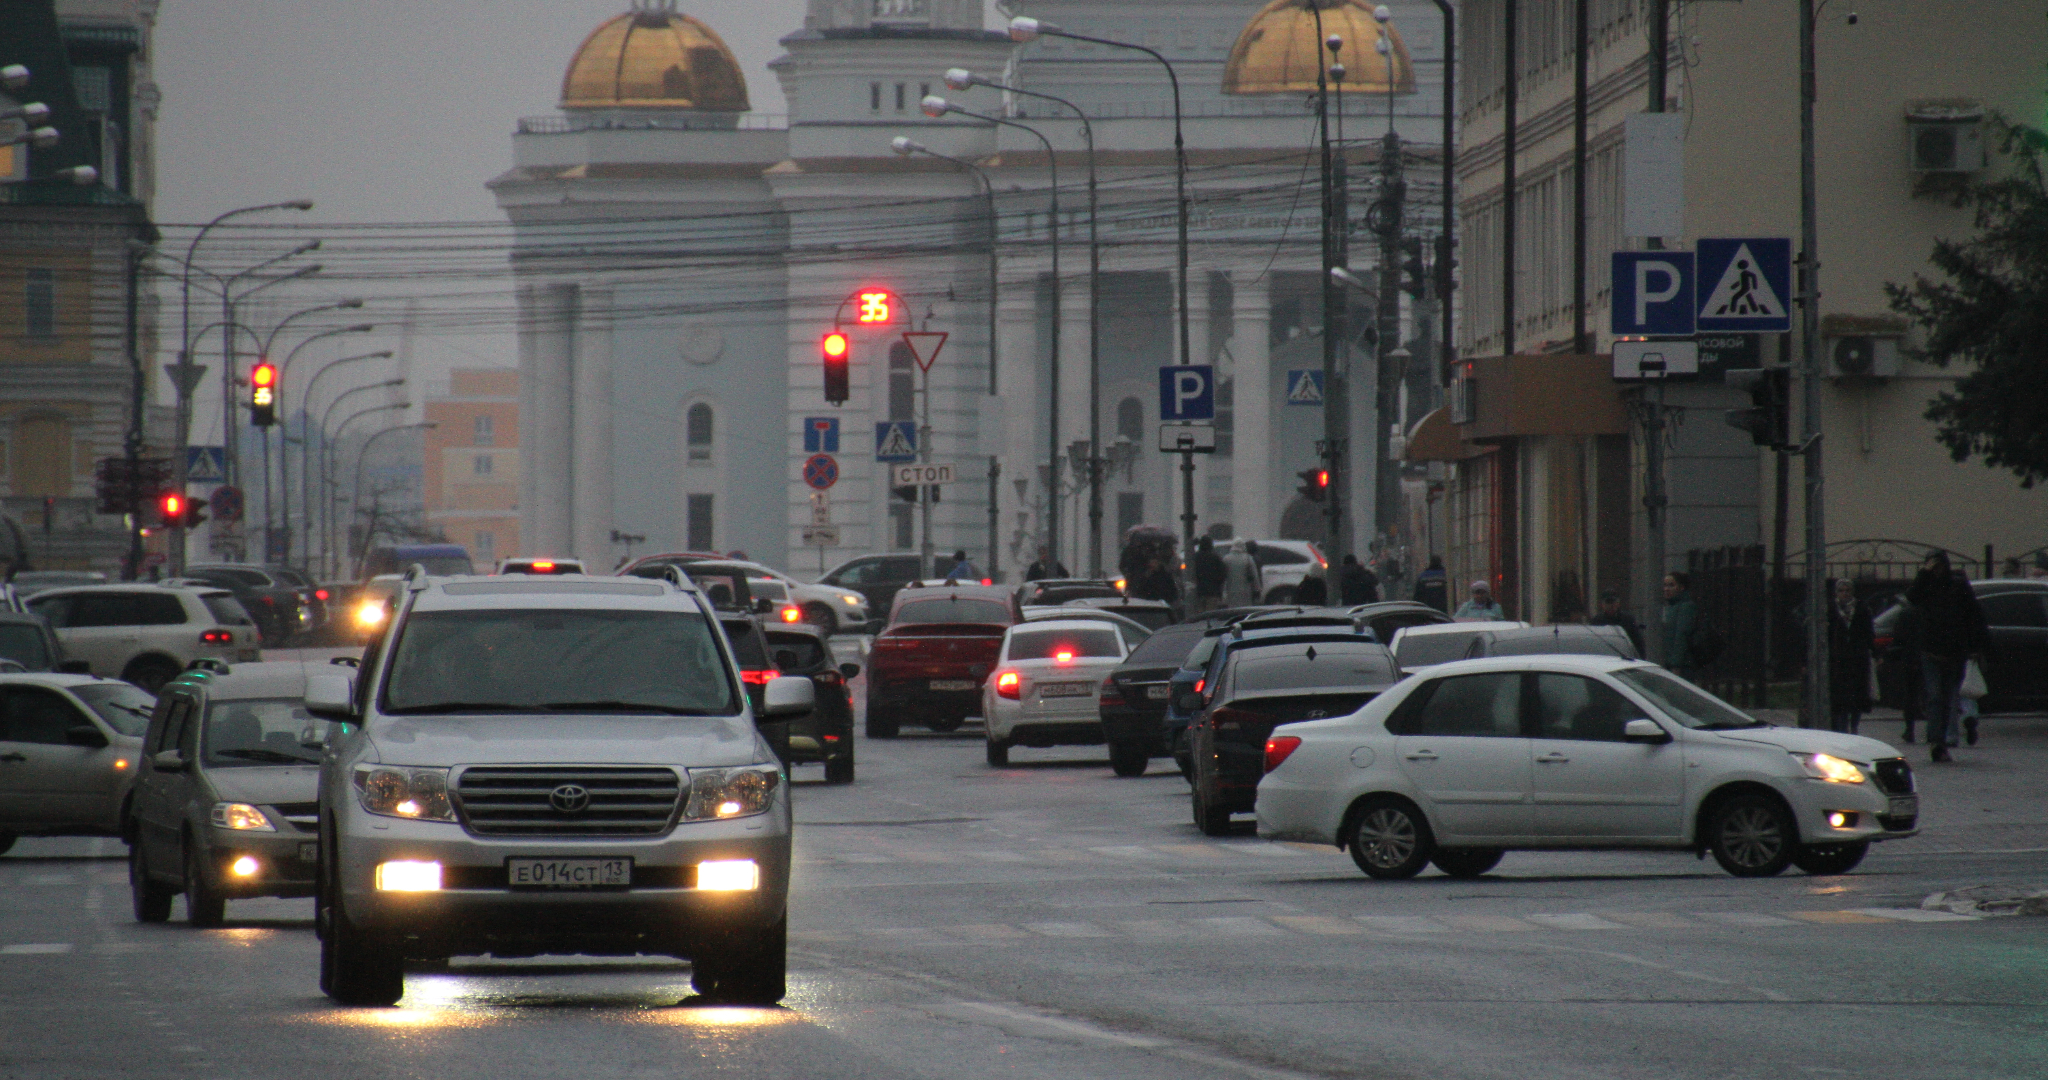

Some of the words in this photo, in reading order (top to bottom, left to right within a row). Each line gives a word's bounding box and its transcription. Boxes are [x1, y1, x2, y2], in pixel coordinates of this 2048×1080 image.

[1635, 260, 1682, 325] P
[860, 293, 889, 322] 35
[1174, 371, 1205, 414] P
[900, 466, 950, 482] СТОП
[517, 862, 598, 882] Е014СТ
[604, 861, 623, 876] 13
